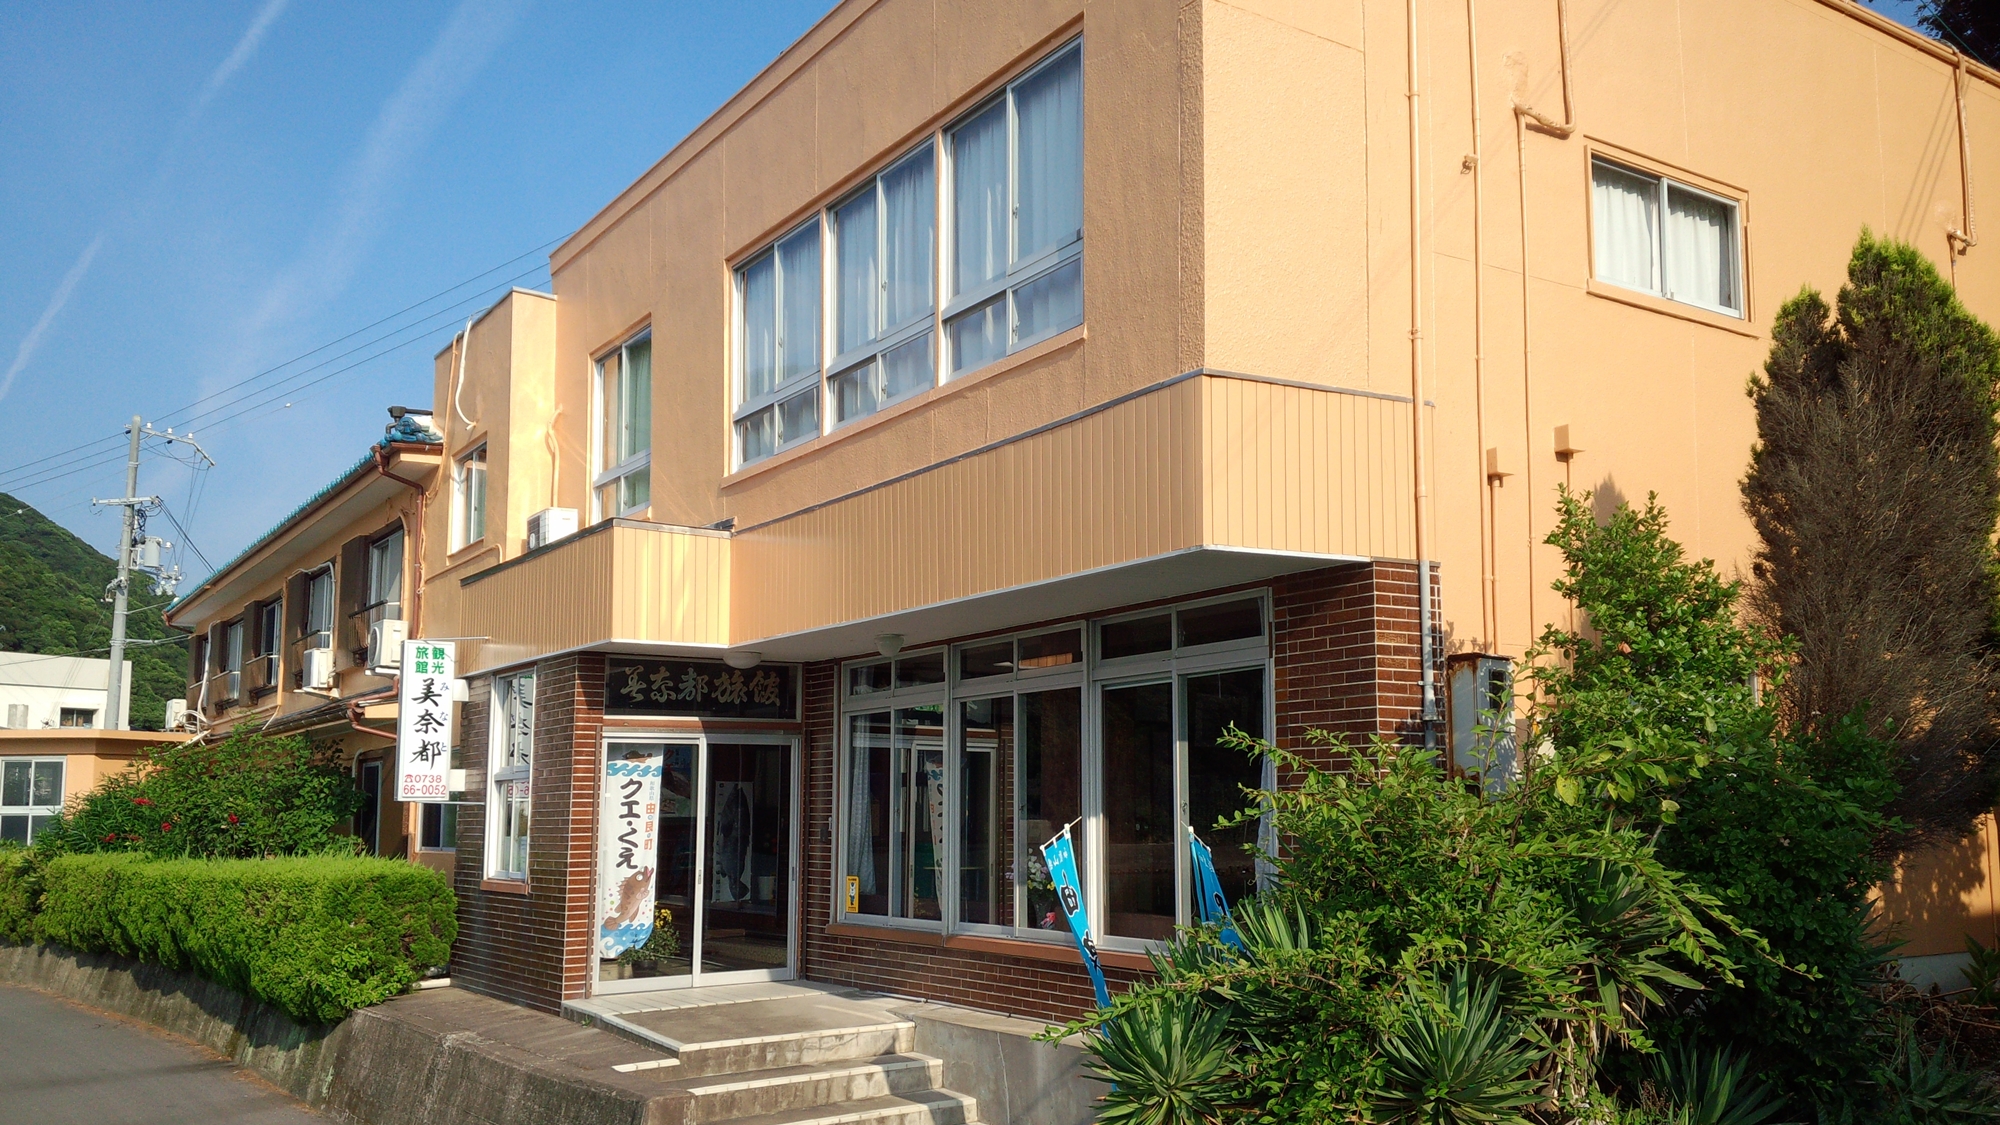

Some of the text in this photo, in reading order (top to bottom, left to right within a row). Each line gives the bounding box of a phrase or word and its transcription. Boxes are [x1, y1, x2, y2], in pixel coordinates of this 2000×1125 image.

[409, 677, 445, 771] 美奈都
[440, 682, 450, 753] みなと
[403, 784, 447, 796] 66-0052
[414, 774, 442, 783] 0738
[616, 778, 643, 870] クエ・くえ
